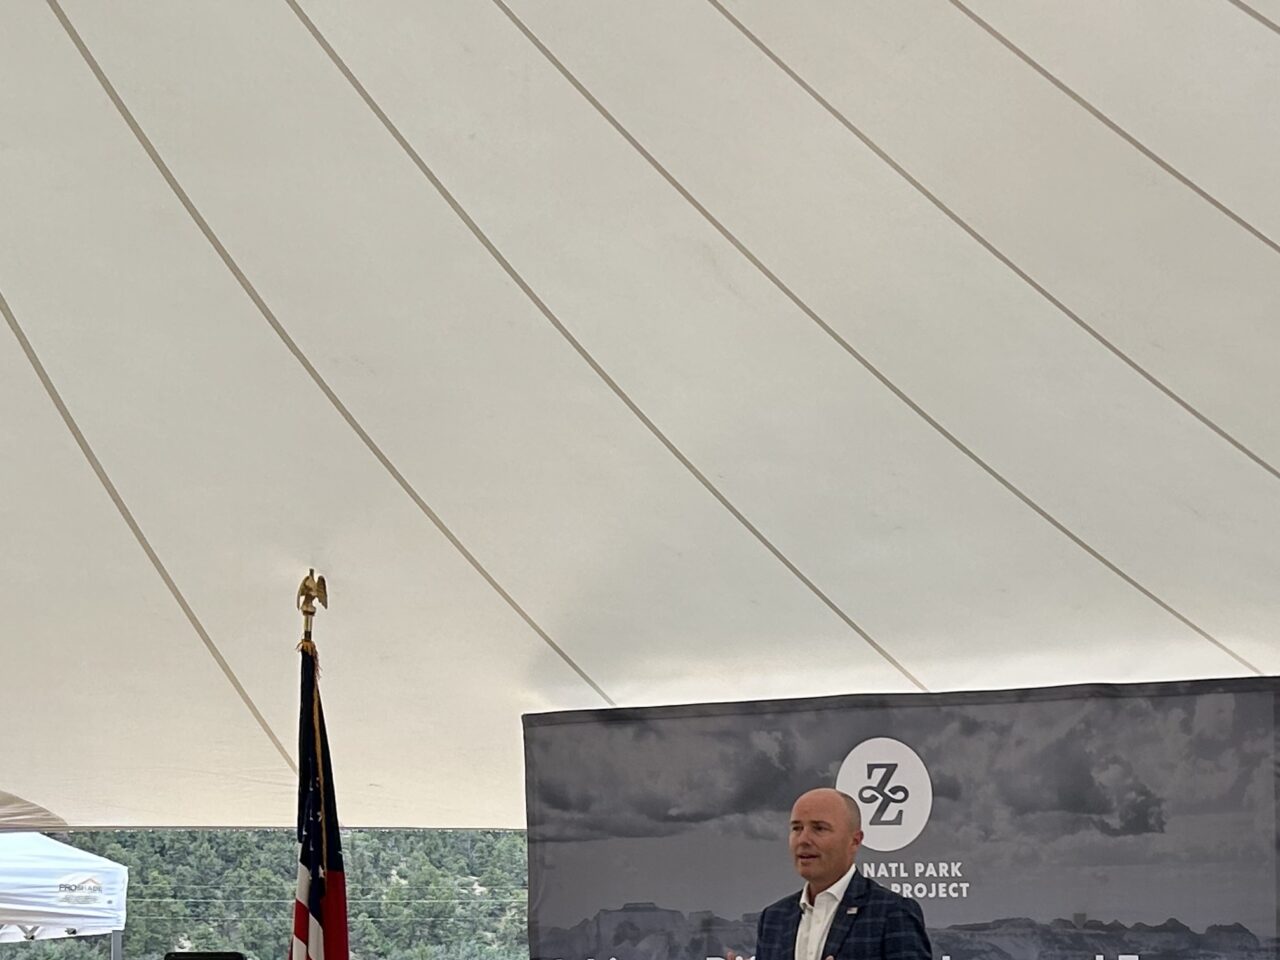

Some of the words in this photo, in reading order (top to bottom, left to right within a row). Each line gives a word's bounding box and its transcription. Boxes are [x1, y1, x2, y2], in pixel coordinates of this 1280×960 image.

[862, 862, 909, 878] NATL
[914, 862, 963, 878] PARK
[891, 883, 970, 898] PROJECT
